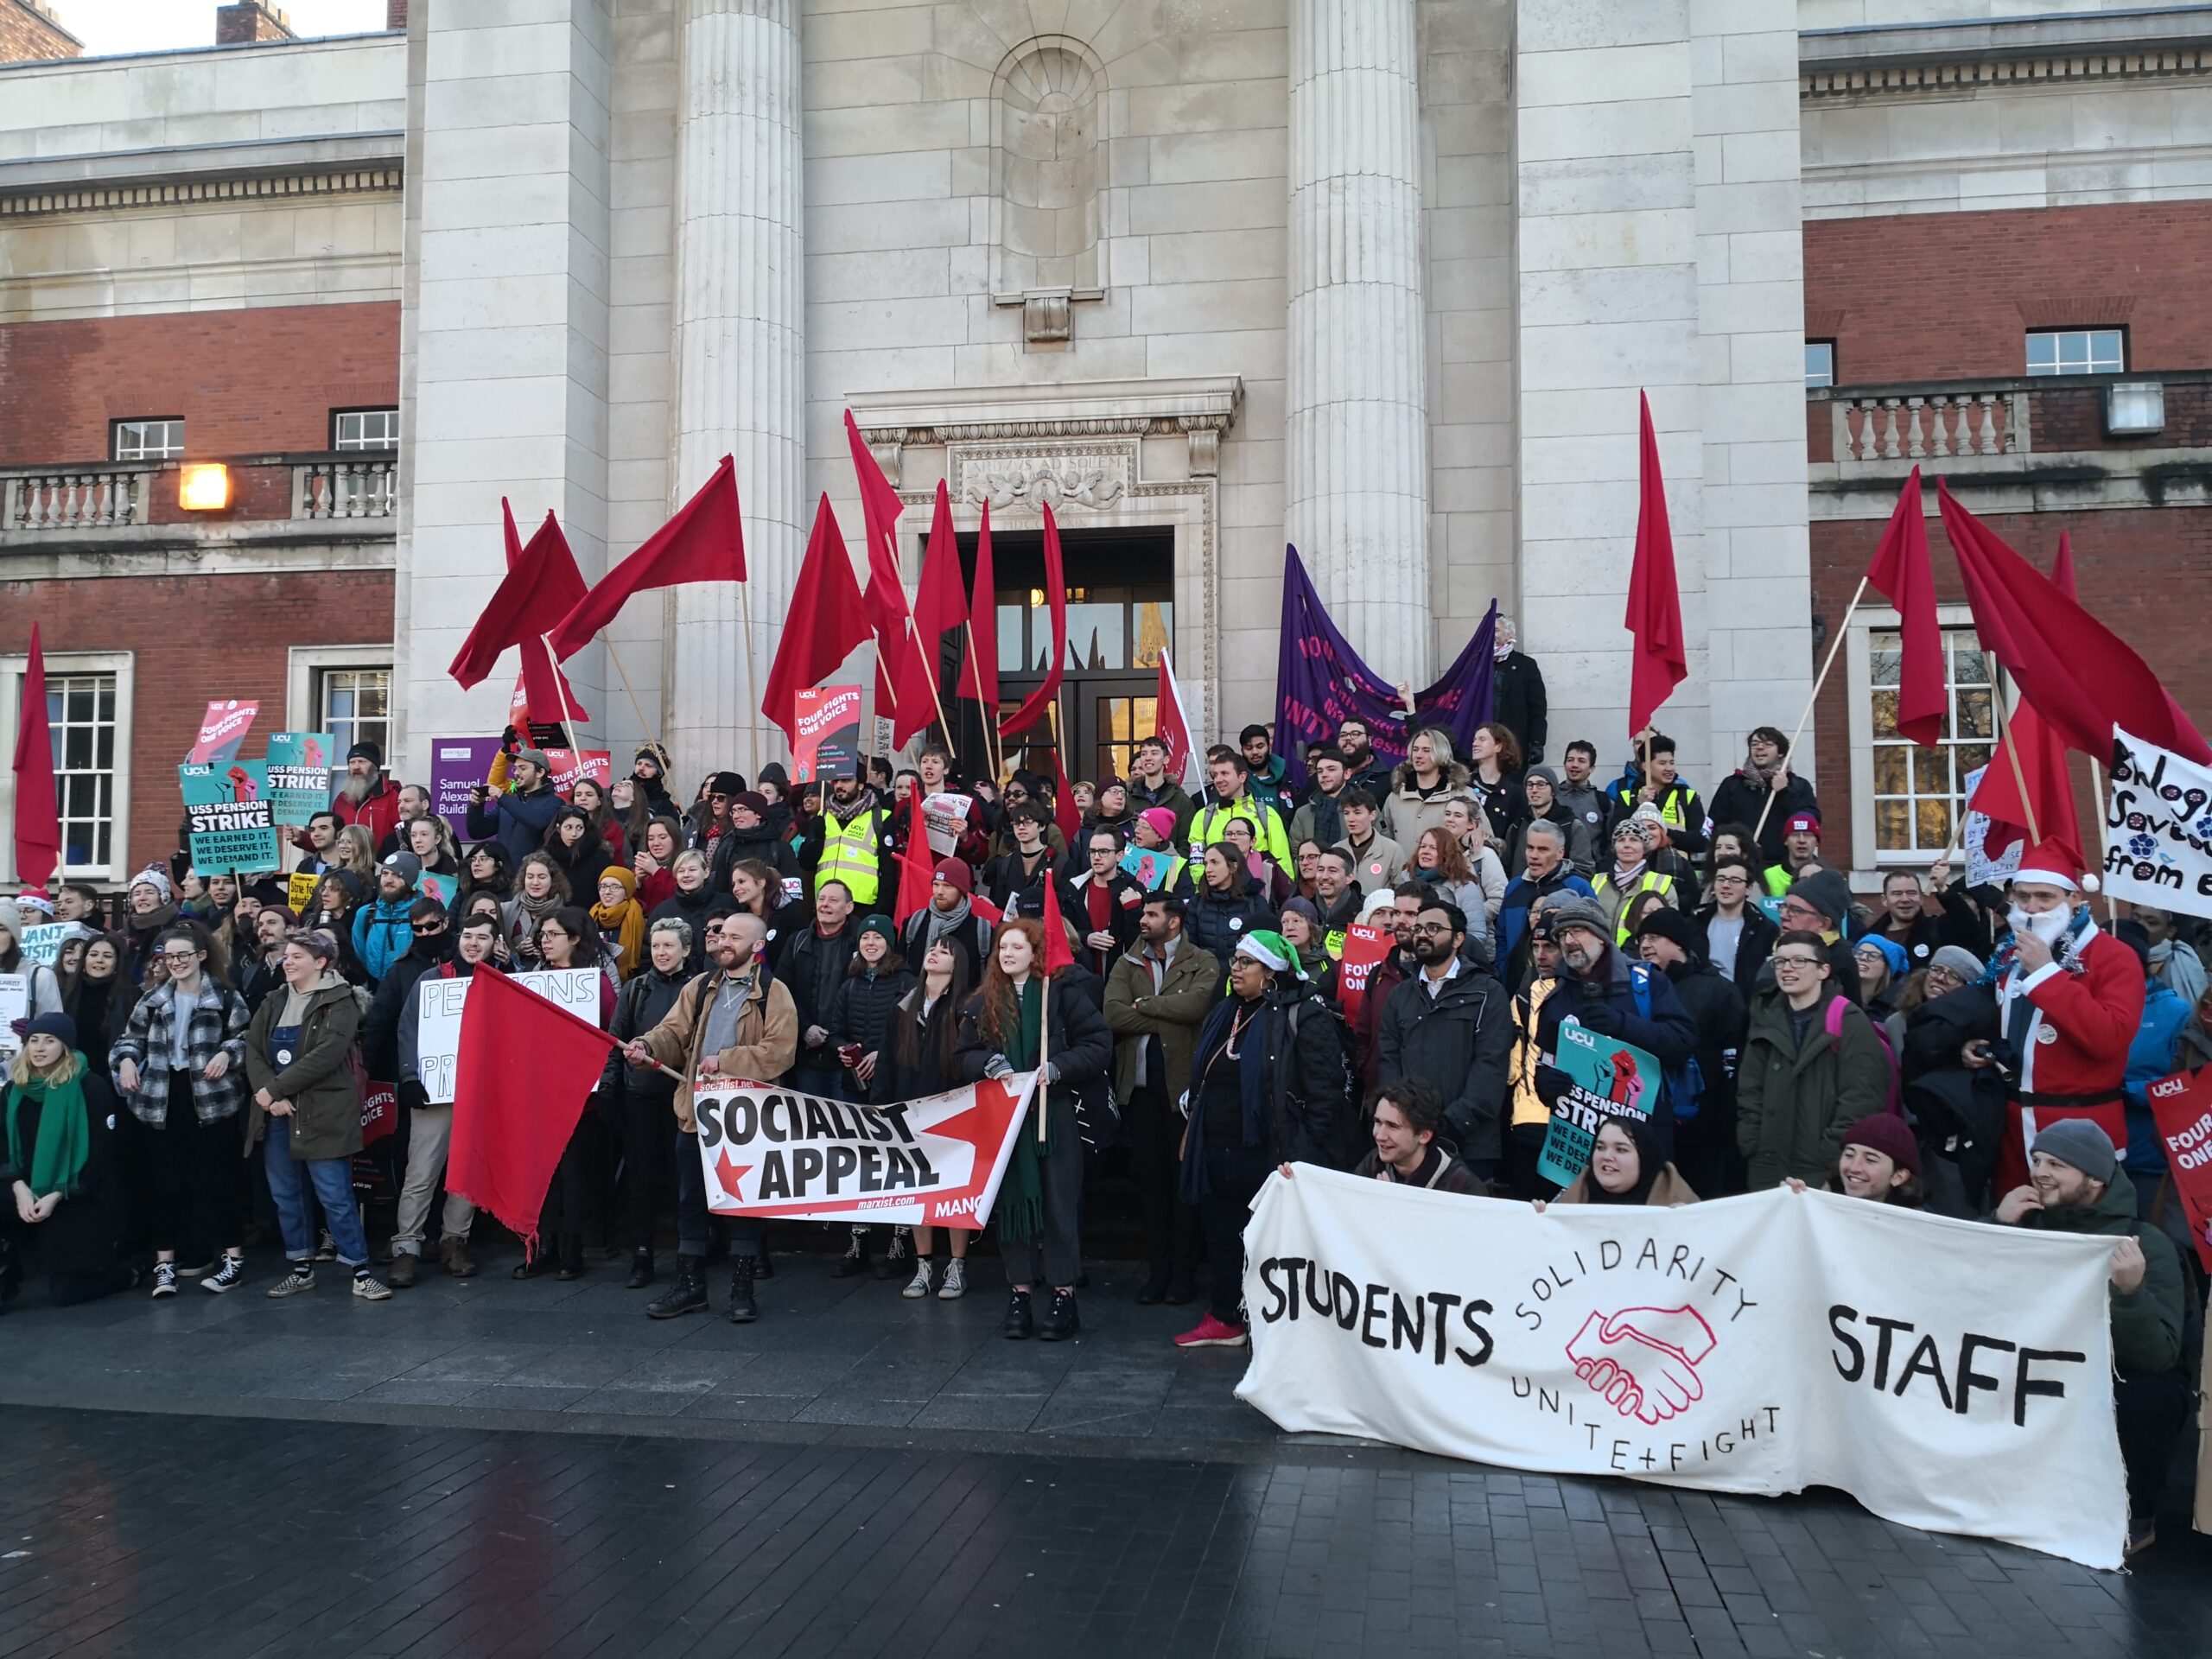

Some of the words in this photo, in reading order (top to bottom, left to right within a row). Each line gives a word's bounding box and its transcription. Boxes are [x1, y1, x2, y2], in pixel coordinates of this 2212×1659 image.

[514, 688, 525, 698] FOU
[798, 709, 823, 727] FOUR
[823, 692, 860, 713] FIGHTS
[799, 722, 819, 735] ONE
[820, 703, 848, 726] VOICE
[201, 721, 225, 734] FOUR
[225, 708, 257, 724] FIGHTS
[218, 717, 243, 736] VOICE
[286, 766, 328, 775] PENSION
[548, 770, 574, 784] OUR
[575, 758, 609, 775] FGHTS
[268, 774, 327, 790] STRIKE
[440, 779, 480, 790] Samuel
[439, 791, 471, 801] Alexa
[188, 804, 213, 815] USS
[213, 800, 269, 814] PENSION
[439, 804, 467, 814] Buildi
[191, 811, 270, 832] STRIKE
[196, 846, 213, 855] WE
[214, 842, 258, 854] DESERVE
[260, 842, 272, 850] IT.
[213, 833, 256, 844] EARNED
[198, 856, 214, 865] WE
[216, 853, 259, 863] DEMAND
[262, 851, 274, 860] IT.
[2104, 845, 2184, 889] from
[784, 880, 801, 889] UC
[1345, 977, 1366, 990] ON
[420, 1053, 455, 1097] PR
[360, 1106, 384, 1127] OICE
[1555, 1095, 1608, 1135] STR
[1583, 1090, 1648, 1122] PENSION
[696, 1095, 916, 1148] SOCIALIST
[1553, 1123, 1569, 1138] WE
[1570, 1131, 1591, 1149] EAR
[2166, 1113, 2212, 1152] FOUR
[1550, 1135, 1567, 1153] WE
[1546, 1150, 1562, 1166] WE
[758, 1145, 939, 1200] APPEAL
[858, 1196, 916, 1210] marxist.com
[1516, 1237, 1758, 1332] SOLIDARITY
[1259, 1256, 1495, 1367] STUDENTS
[1828, 1304, 2086, 1427] STAFF
